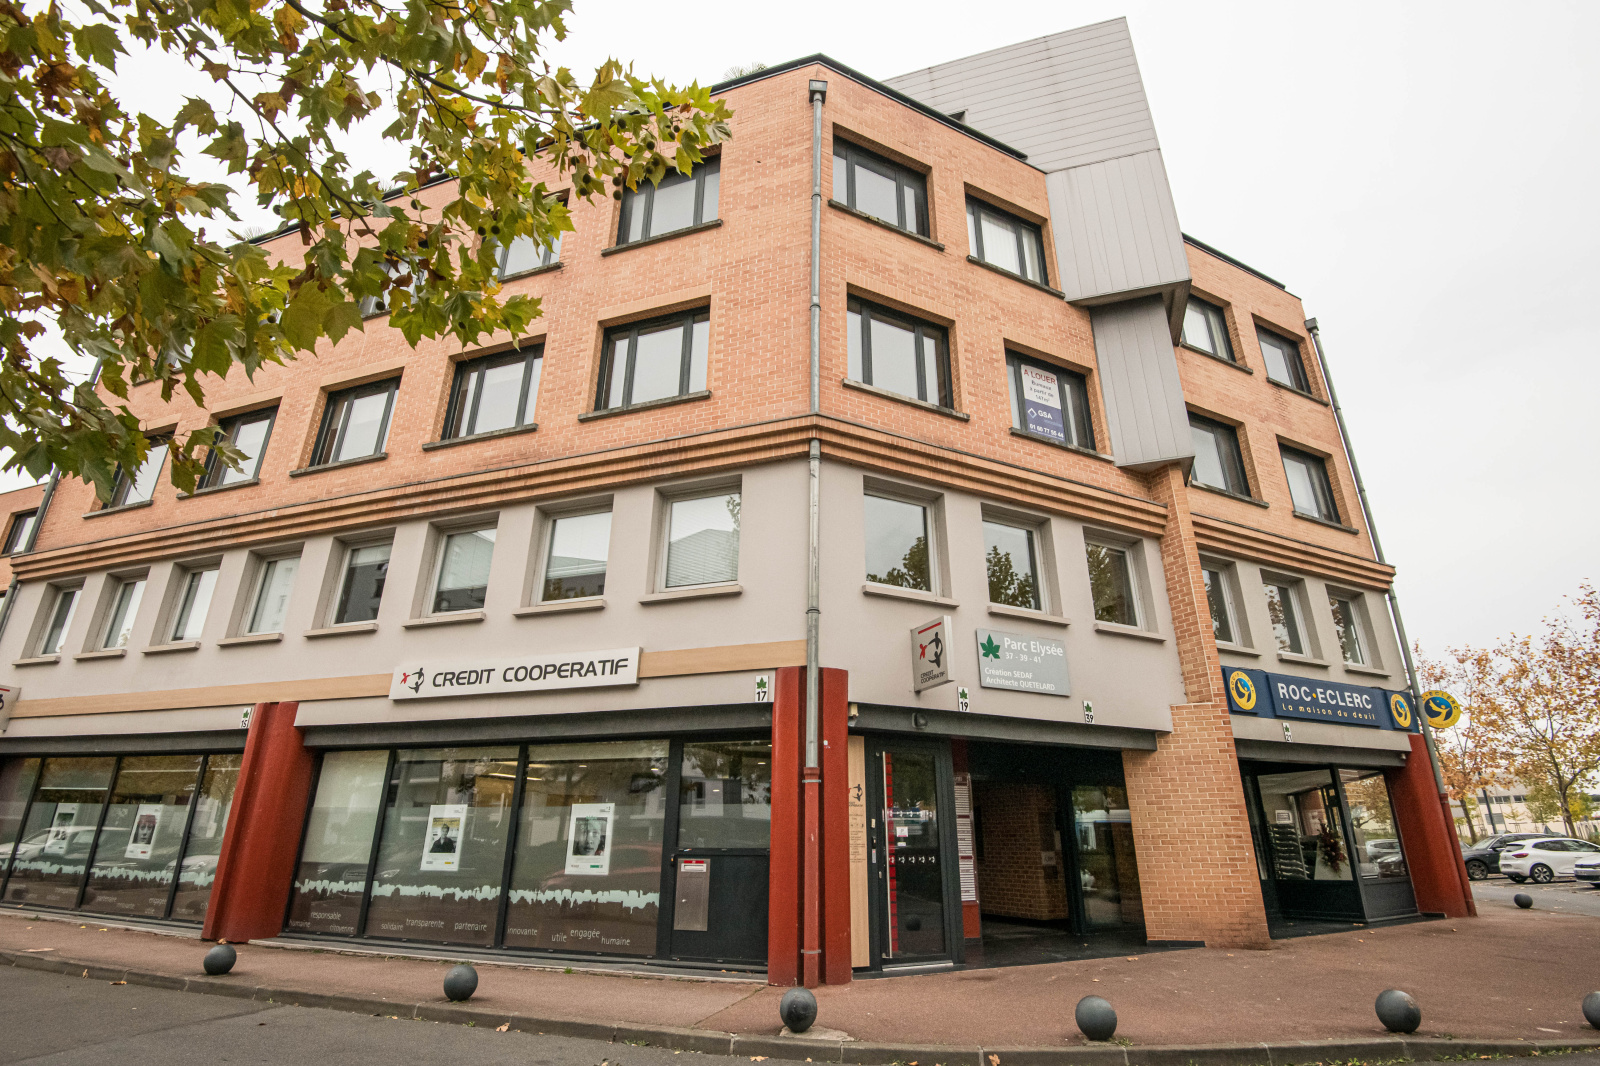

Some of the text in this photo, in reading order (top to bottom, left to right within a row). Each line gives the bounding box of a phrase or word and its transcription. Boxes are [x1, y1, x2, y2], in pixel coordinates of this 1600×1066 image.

[1031, 371, 1056, 385] LOUER
[1038, 410, 1052, 419] GSA
[1004, 637, 1063, 656] Parc Elysée
[1020, 654, 1027, 662] 39
[432, 658, 628, 687] CREDIT COOPERATIF
[921, 670, 934, 679] CREDIT
[921, 671, 945, 684] COOPERATIF
[985, 667, 1032, 679] Création SEDAF
[986, 676, 1055, 690] Architecte QUETELARD
[756, 691, 767, 701] 17
[960, 701, 968, 711] 19
[1299, 706, 1332, 715] maison
[1337, 709, 1348, 717] du
[1352, 711, 1375, 720] deuil
[241, 719, 248, 728] 15
[1086, 714, 1093, 723] 39
[311, 911, 341, 920] responsable
[289, 919, 311, 928] humaine
[329, 924, 354, 932] citoyenne
[381, 922, 404, 931] solidaire
[405, 918, 445, 930] transparente
[454, 921, 487, 931] partenaire
[507, 926, 538, 936] innovante
[570, 929, 600, 939] engagée
[551, 933, 567, 942] utile
[601, 936, 630, 945] humaine
